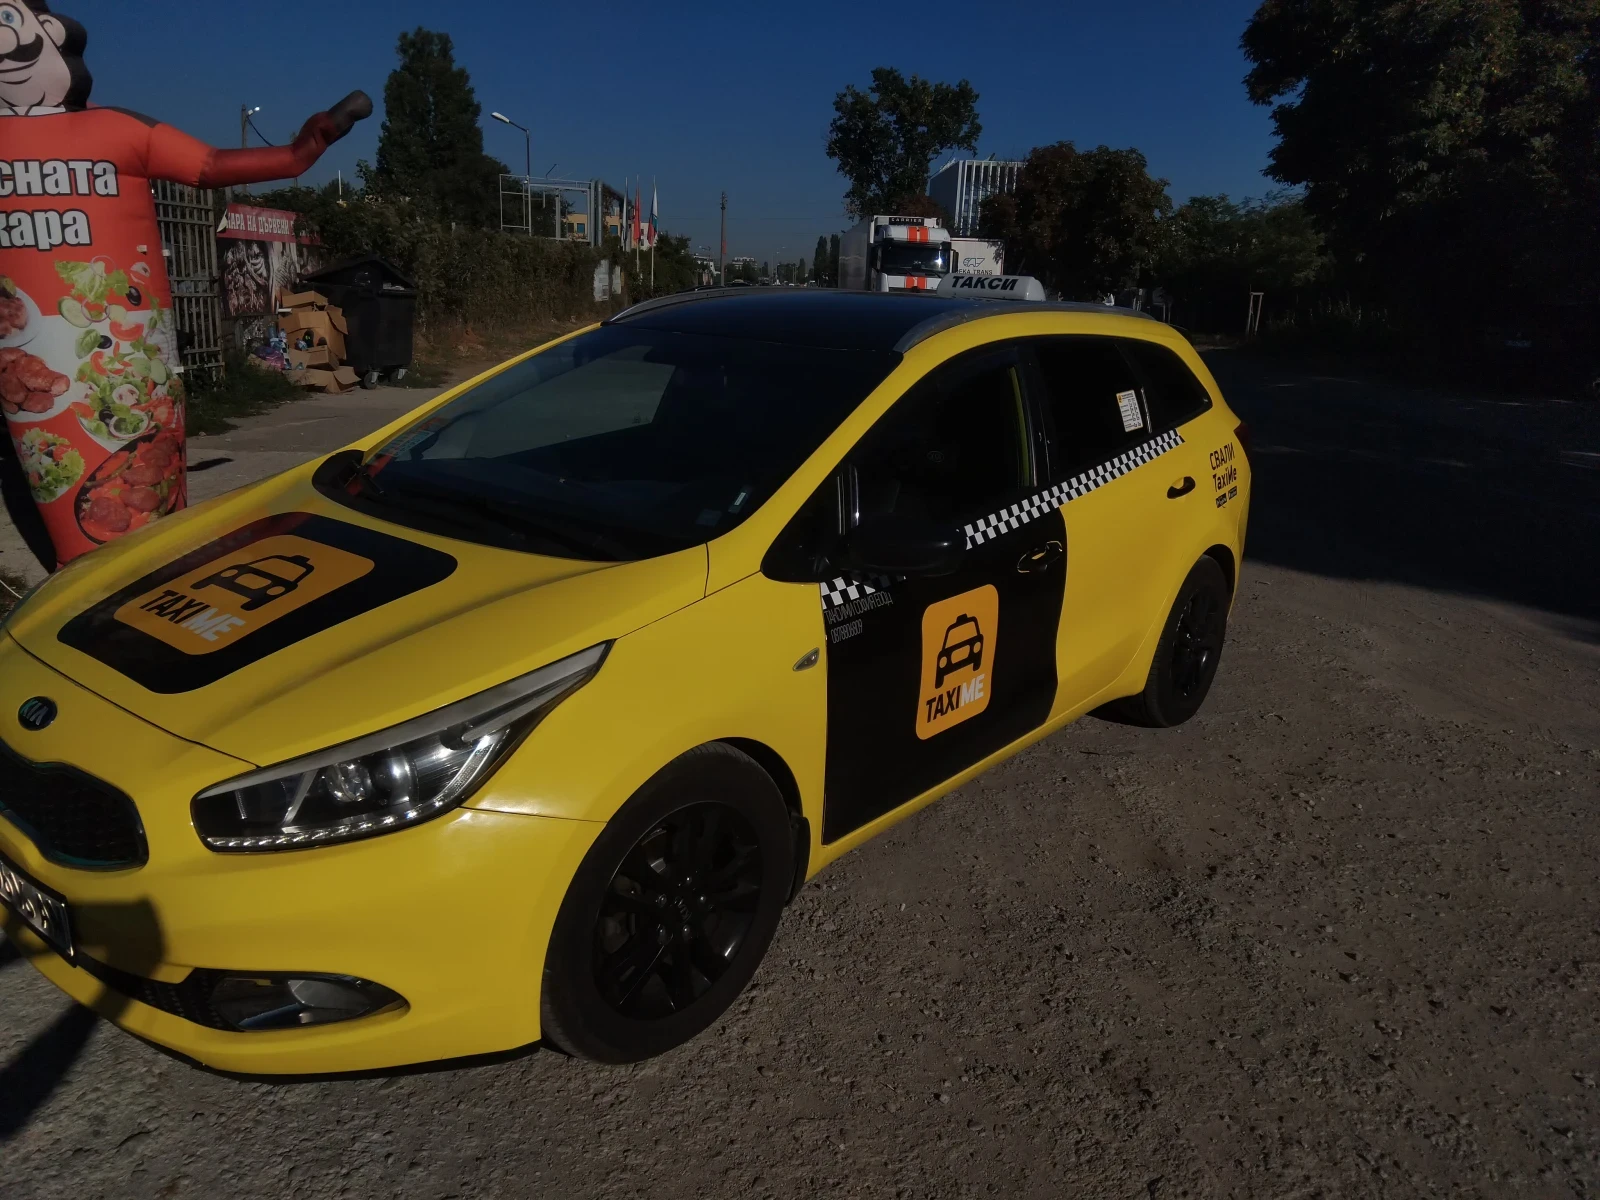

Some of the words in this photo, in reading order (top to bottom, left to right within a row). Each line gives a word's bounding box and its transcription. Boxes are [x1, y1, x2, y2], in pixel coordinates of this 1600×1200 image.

[246, 215, 257, 231] НА
[952, 275, 1019, 291] ТАКСИ
[1209, 442, 1236, 471] СВАЛИ
[1212, 465, 1237, 492] TaxiMe
[853, 594, 876, 615] СОФИЯ
[874, 590, 894, 608] ЕООД
[20, 699, 49, 726] KIA
